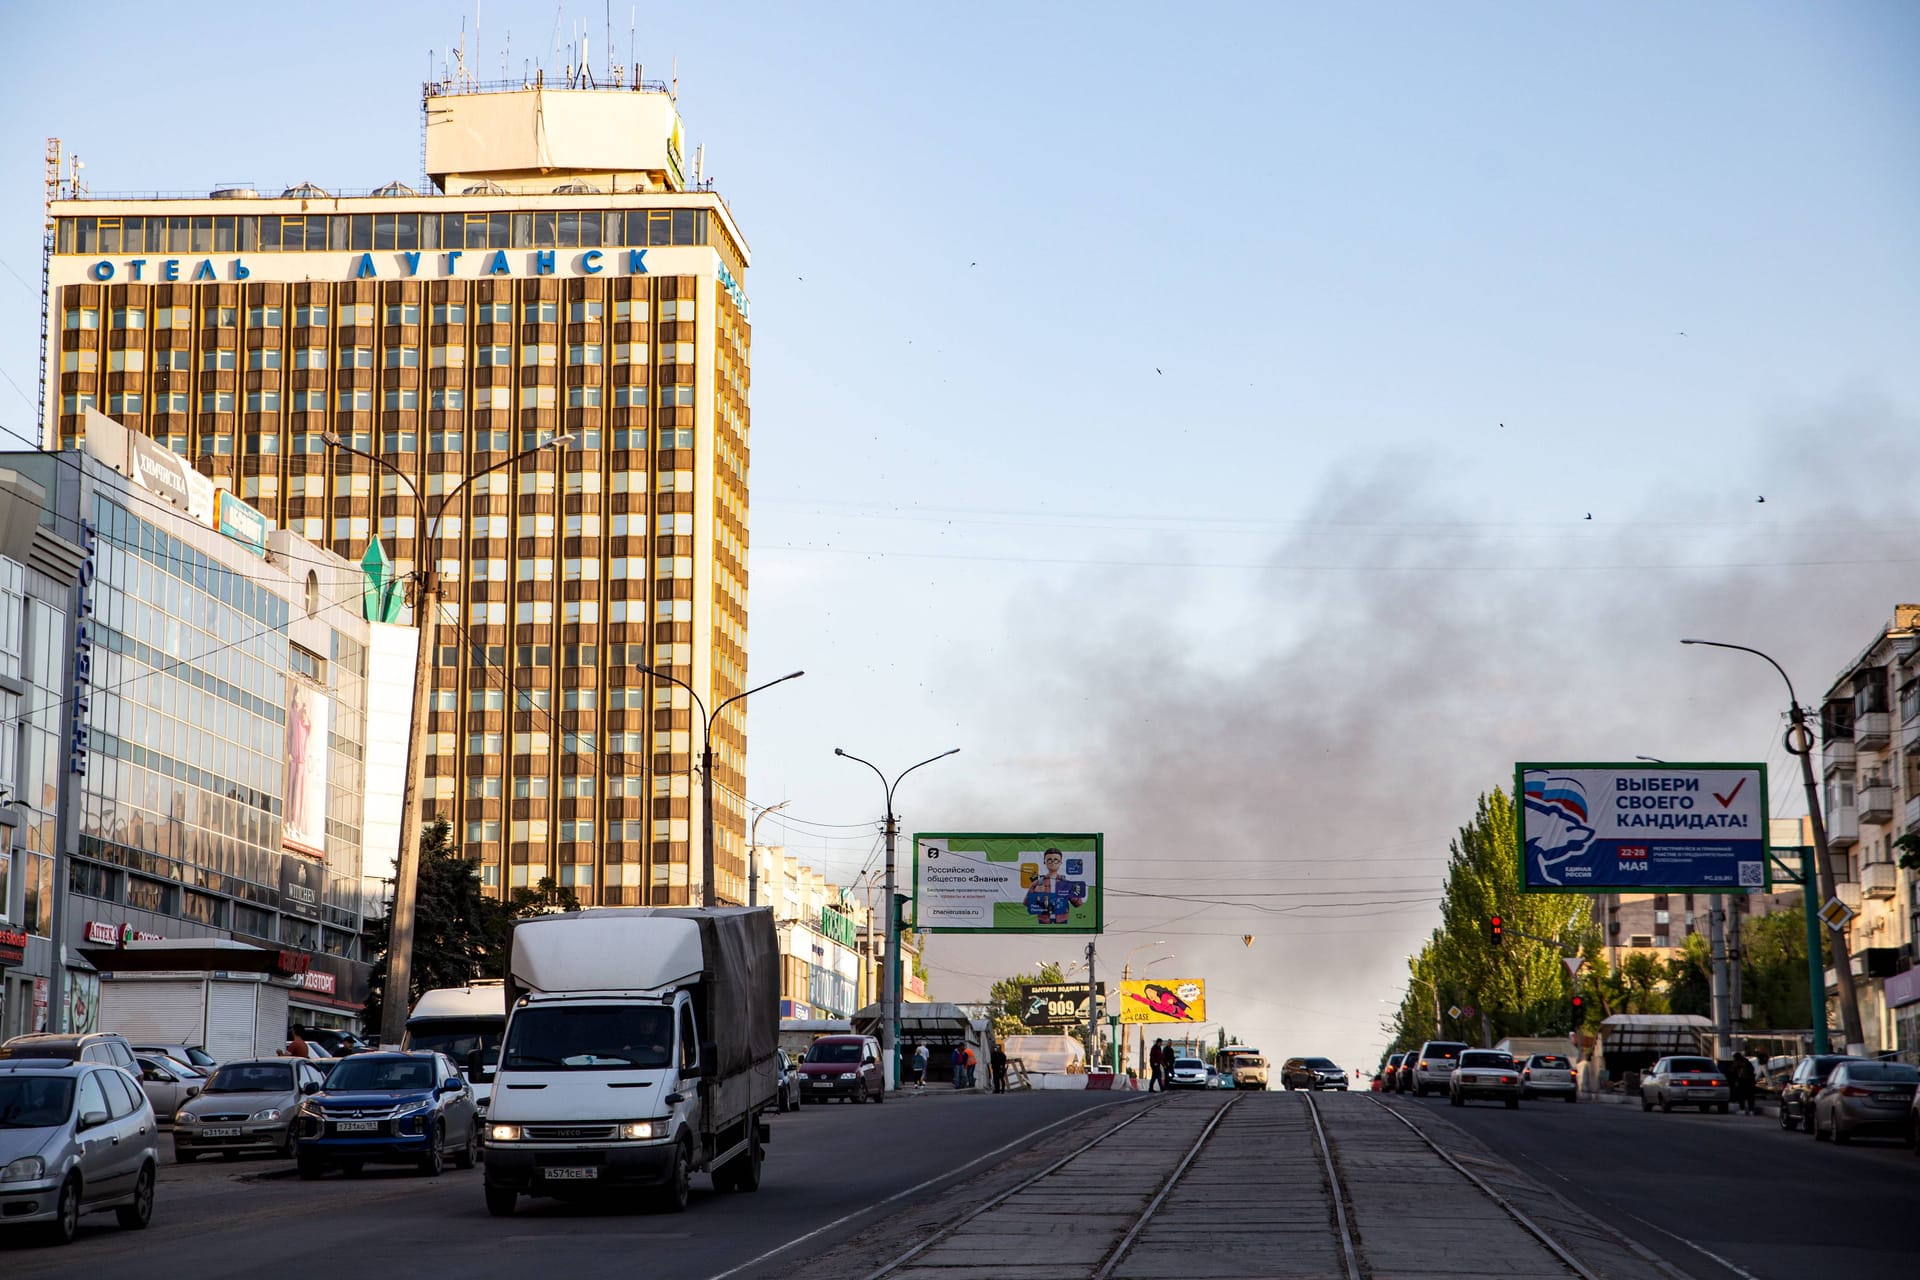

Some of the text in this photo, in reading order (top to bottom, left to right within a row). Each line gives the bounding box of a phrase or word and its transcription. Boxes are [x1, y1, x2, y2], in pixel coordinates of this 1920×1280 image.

[95, 249, 649, 281] ОТЕЛЬ ЛУГАНСК
[140, 453, 187, 496] ХИМЧИСТКА
[1615, 777, 1699, 792] ВЫБЕРИ
[1615, 796, 1694, 809] СВОЕГО
[1616, 814, 1748, 830] КАНДИДАТА!
[1620, 849, 1646, 857] 22-28
[927, 865, 975, 874] Российское
[1619, 861, 1648, 871] МАЯ
[927, 875, 1009, 883] общество «Знание»
[90, 922, 118, 944] АПТЕКА
[1048, 1001, 1074, 1016] 909
[1134, 1013, 1149, 1021] CASE
[547, 1169, 582, 1178] А571СЕ
